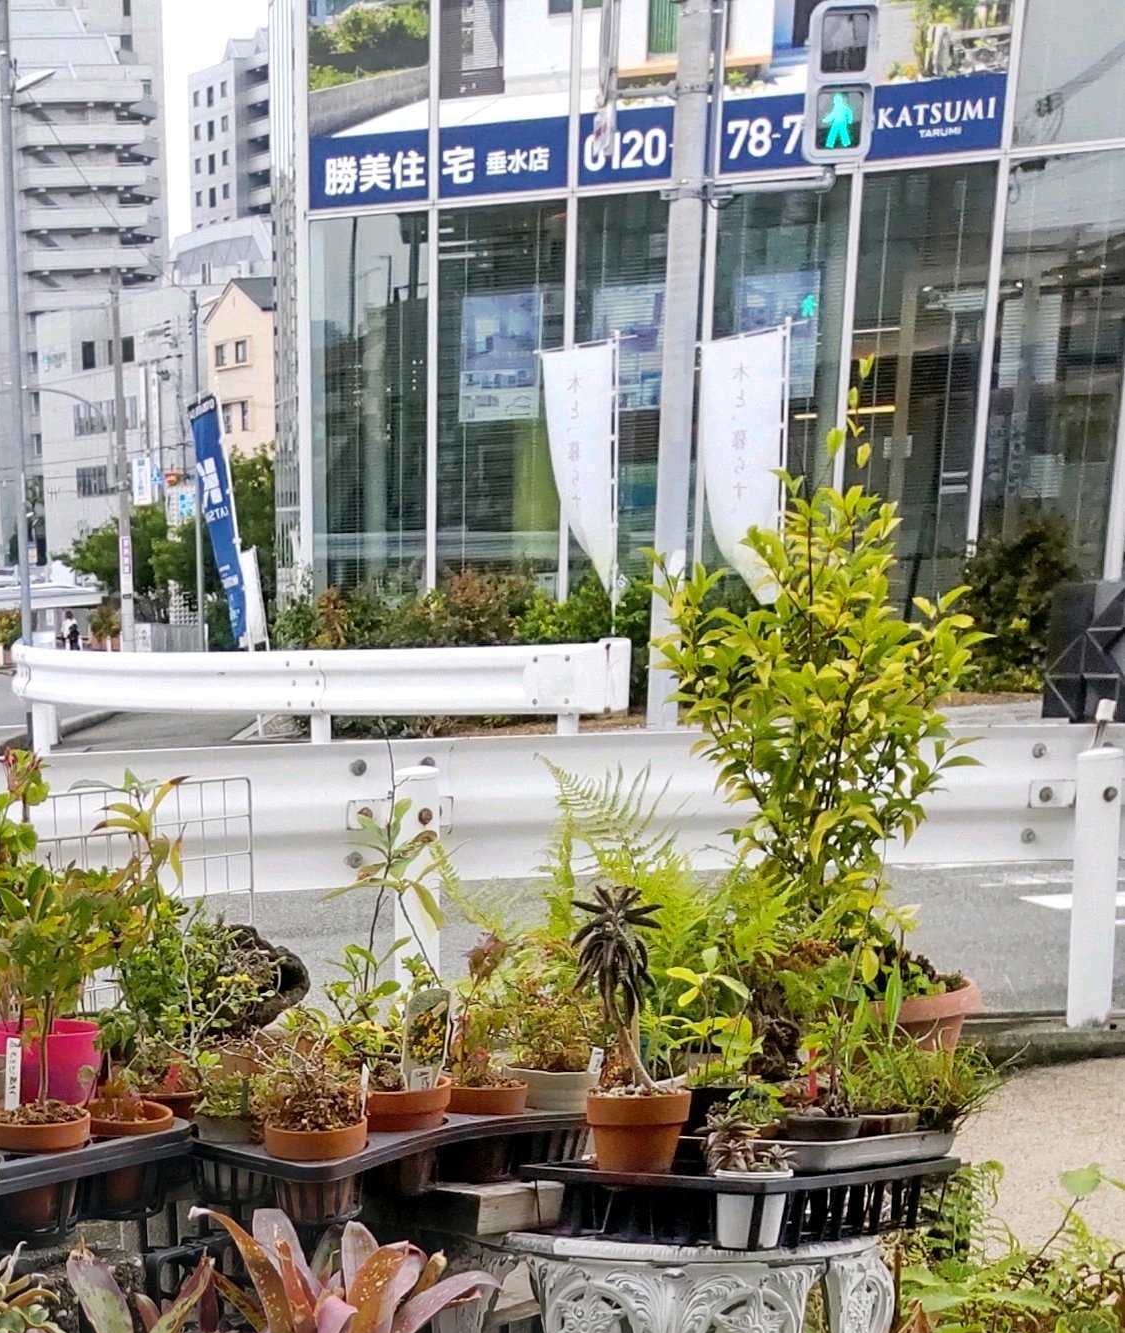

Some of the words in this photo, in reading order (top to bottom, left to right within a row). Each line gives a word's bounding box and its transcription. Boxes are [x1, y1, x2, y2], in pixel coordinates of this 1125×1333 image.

[877, 97, 996, 129] KATSUMI
[919, 126, 963, 138] TARUMI
[325, 146, 475, 196] 勝美住宅
[486, 147, 550, 176] 垂水店
